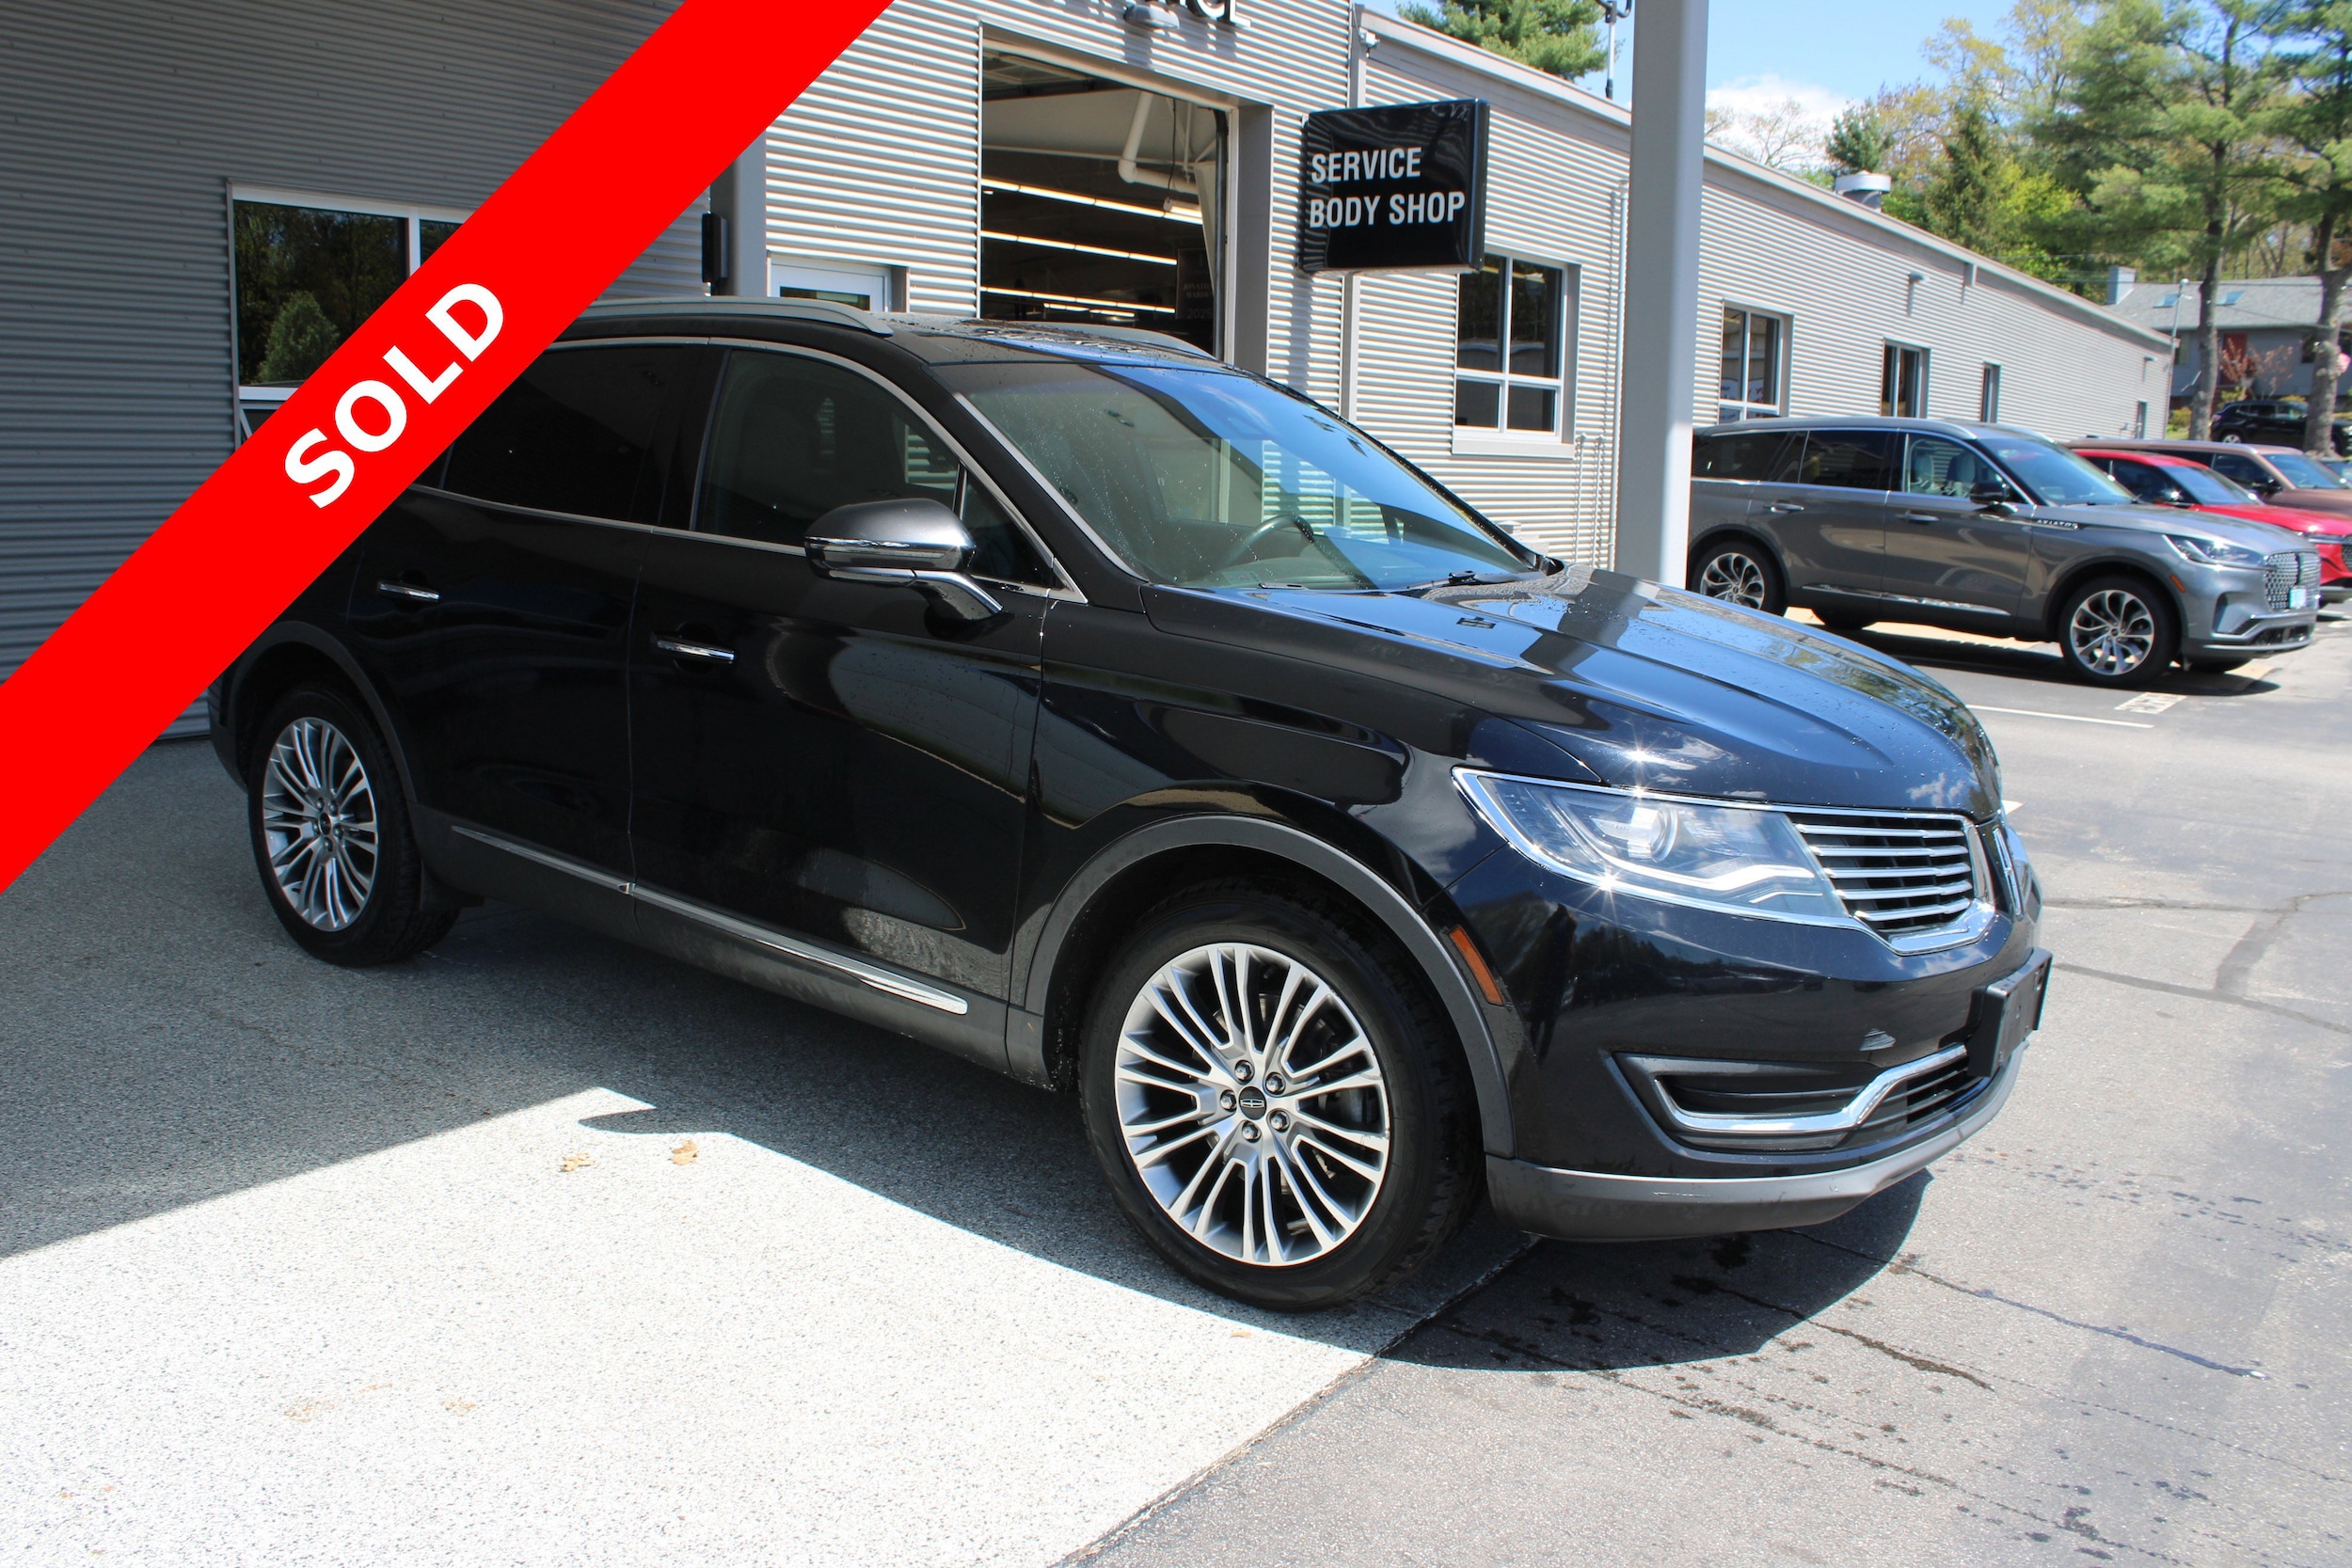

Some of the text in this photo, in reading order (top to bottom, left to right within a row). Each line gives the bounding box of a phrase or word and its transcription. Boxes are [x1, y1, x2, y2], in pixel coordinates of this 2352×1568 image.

[1311, 147, 1422, 184] SERVICE
[1310, 191, 1466, 229] BODY SHOP
